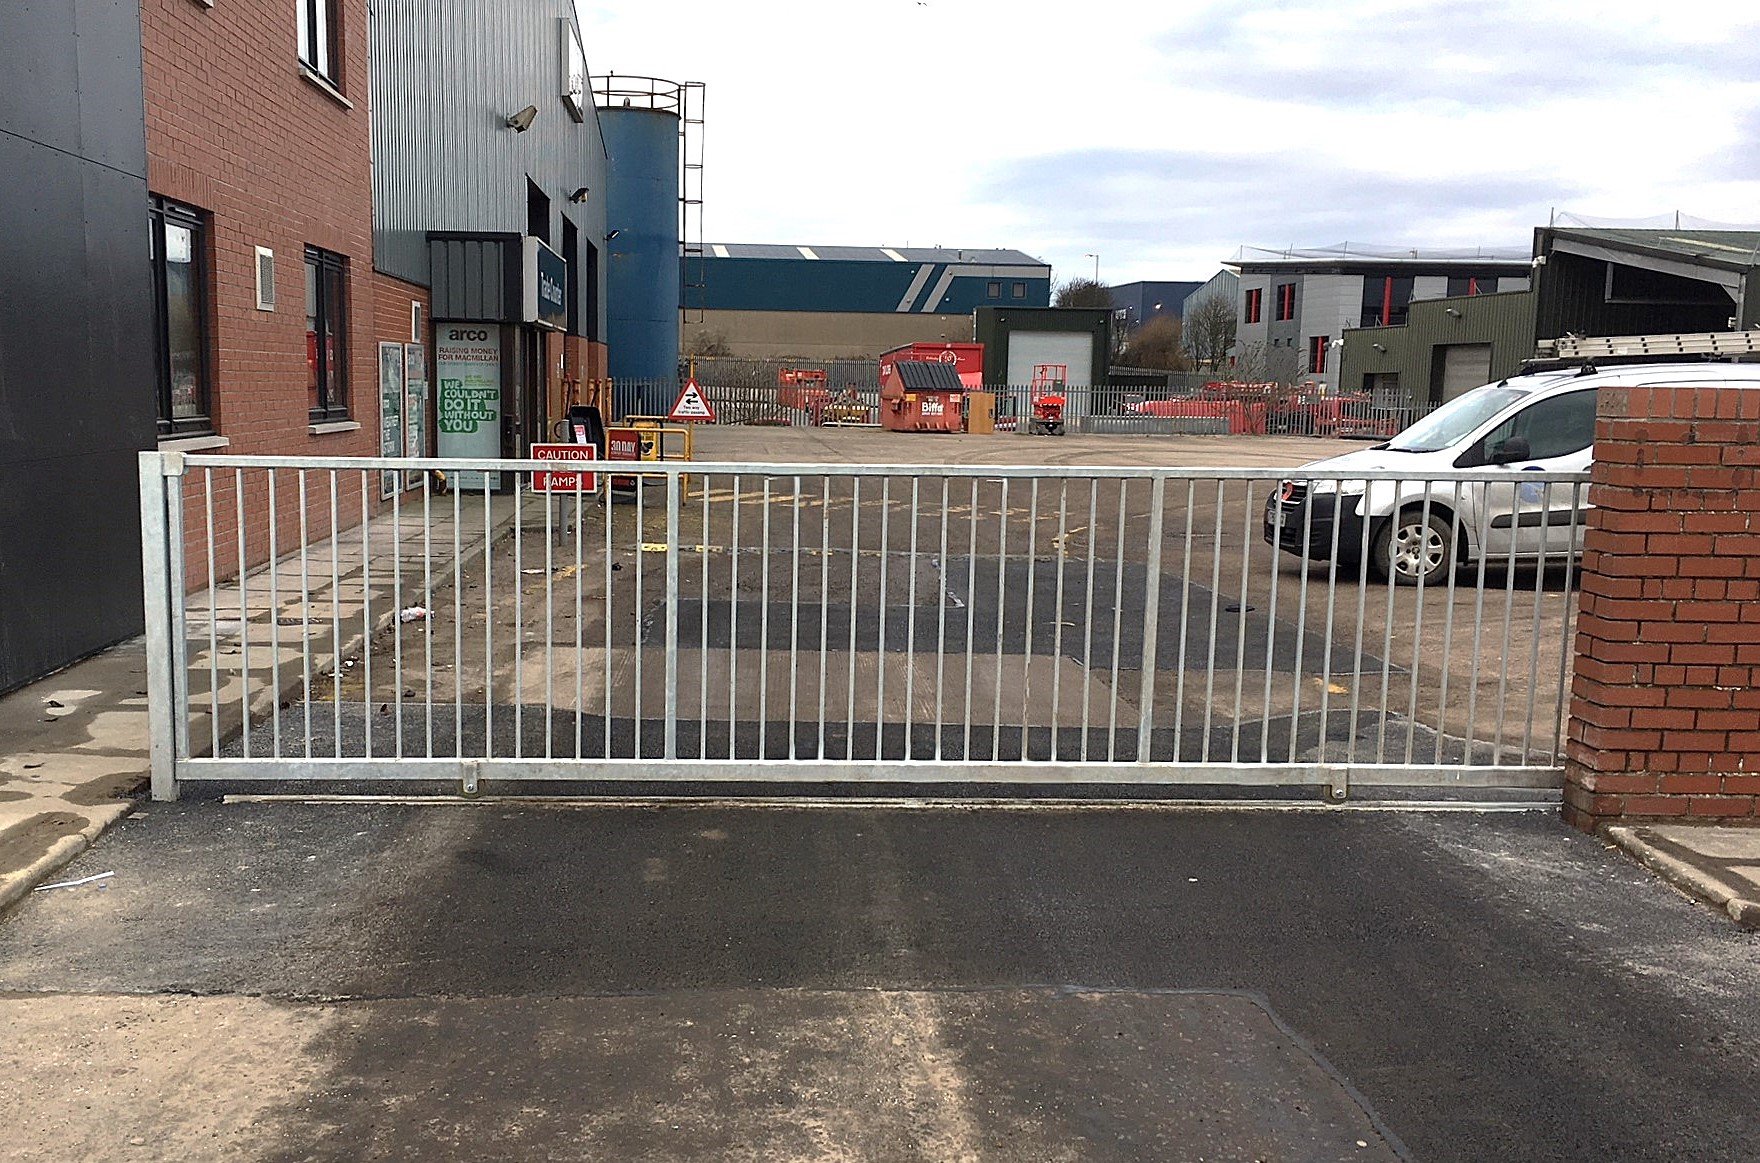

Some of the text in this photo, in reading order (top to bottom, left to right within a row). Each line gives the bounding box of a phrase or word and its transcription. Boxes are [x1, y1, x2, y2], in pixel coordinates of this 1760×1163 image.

[449, 329, 488, 341] arco
[444, 380, 461, 389] WE
[444, 389, 496, 399] COULDN'T
[444, 398, 481, 410] DO IT
[922, 402, 944, 413] Biffa
[444, 410, 494, 420] WITHOUT
[444, 419, 473, 432] YOU
[611, 440, 636, 453] 30 DAY
[537, 450, 589, 460] CAUTION
